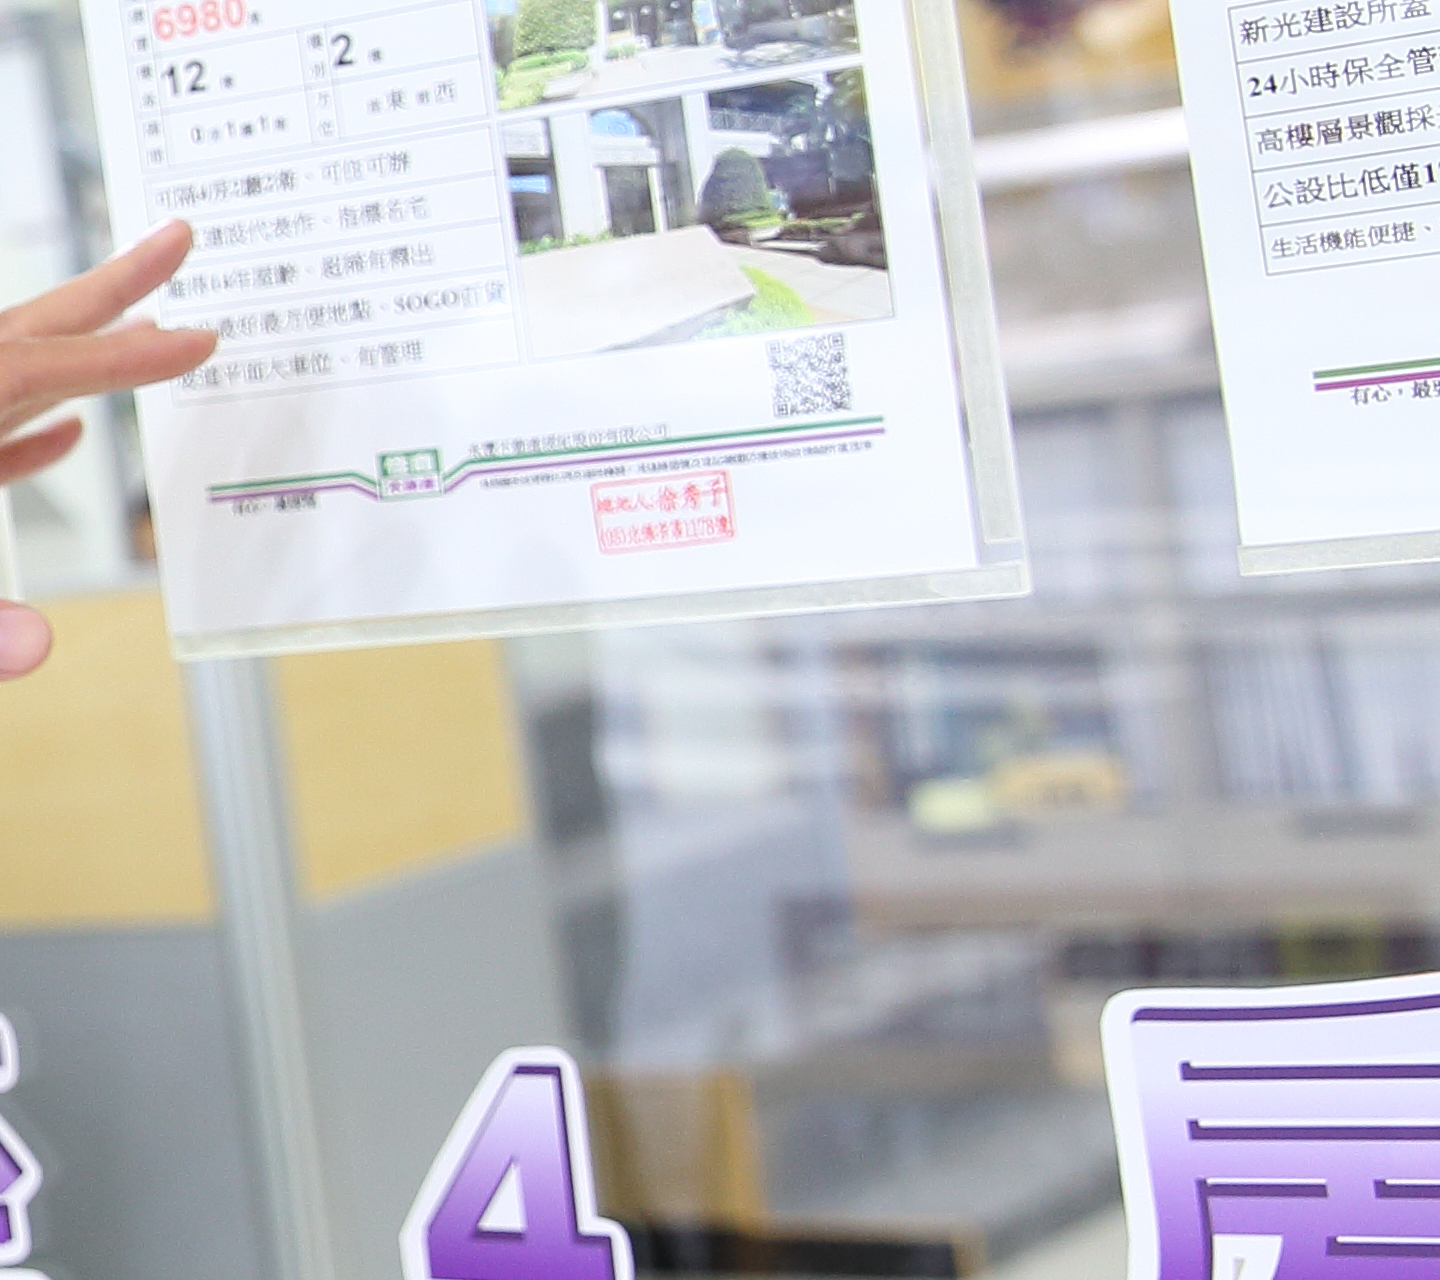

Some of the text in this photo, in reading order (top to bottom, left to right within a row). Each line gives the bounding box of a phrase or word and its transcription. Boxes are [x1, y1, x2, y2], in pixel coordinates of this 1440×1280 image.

[1246, 42, 1440, 99] 24小時保全管
[1255, 101, 1440, 155] 高樓層景觀採
[1262, 157, 1440, 211] 公設比低僅1
